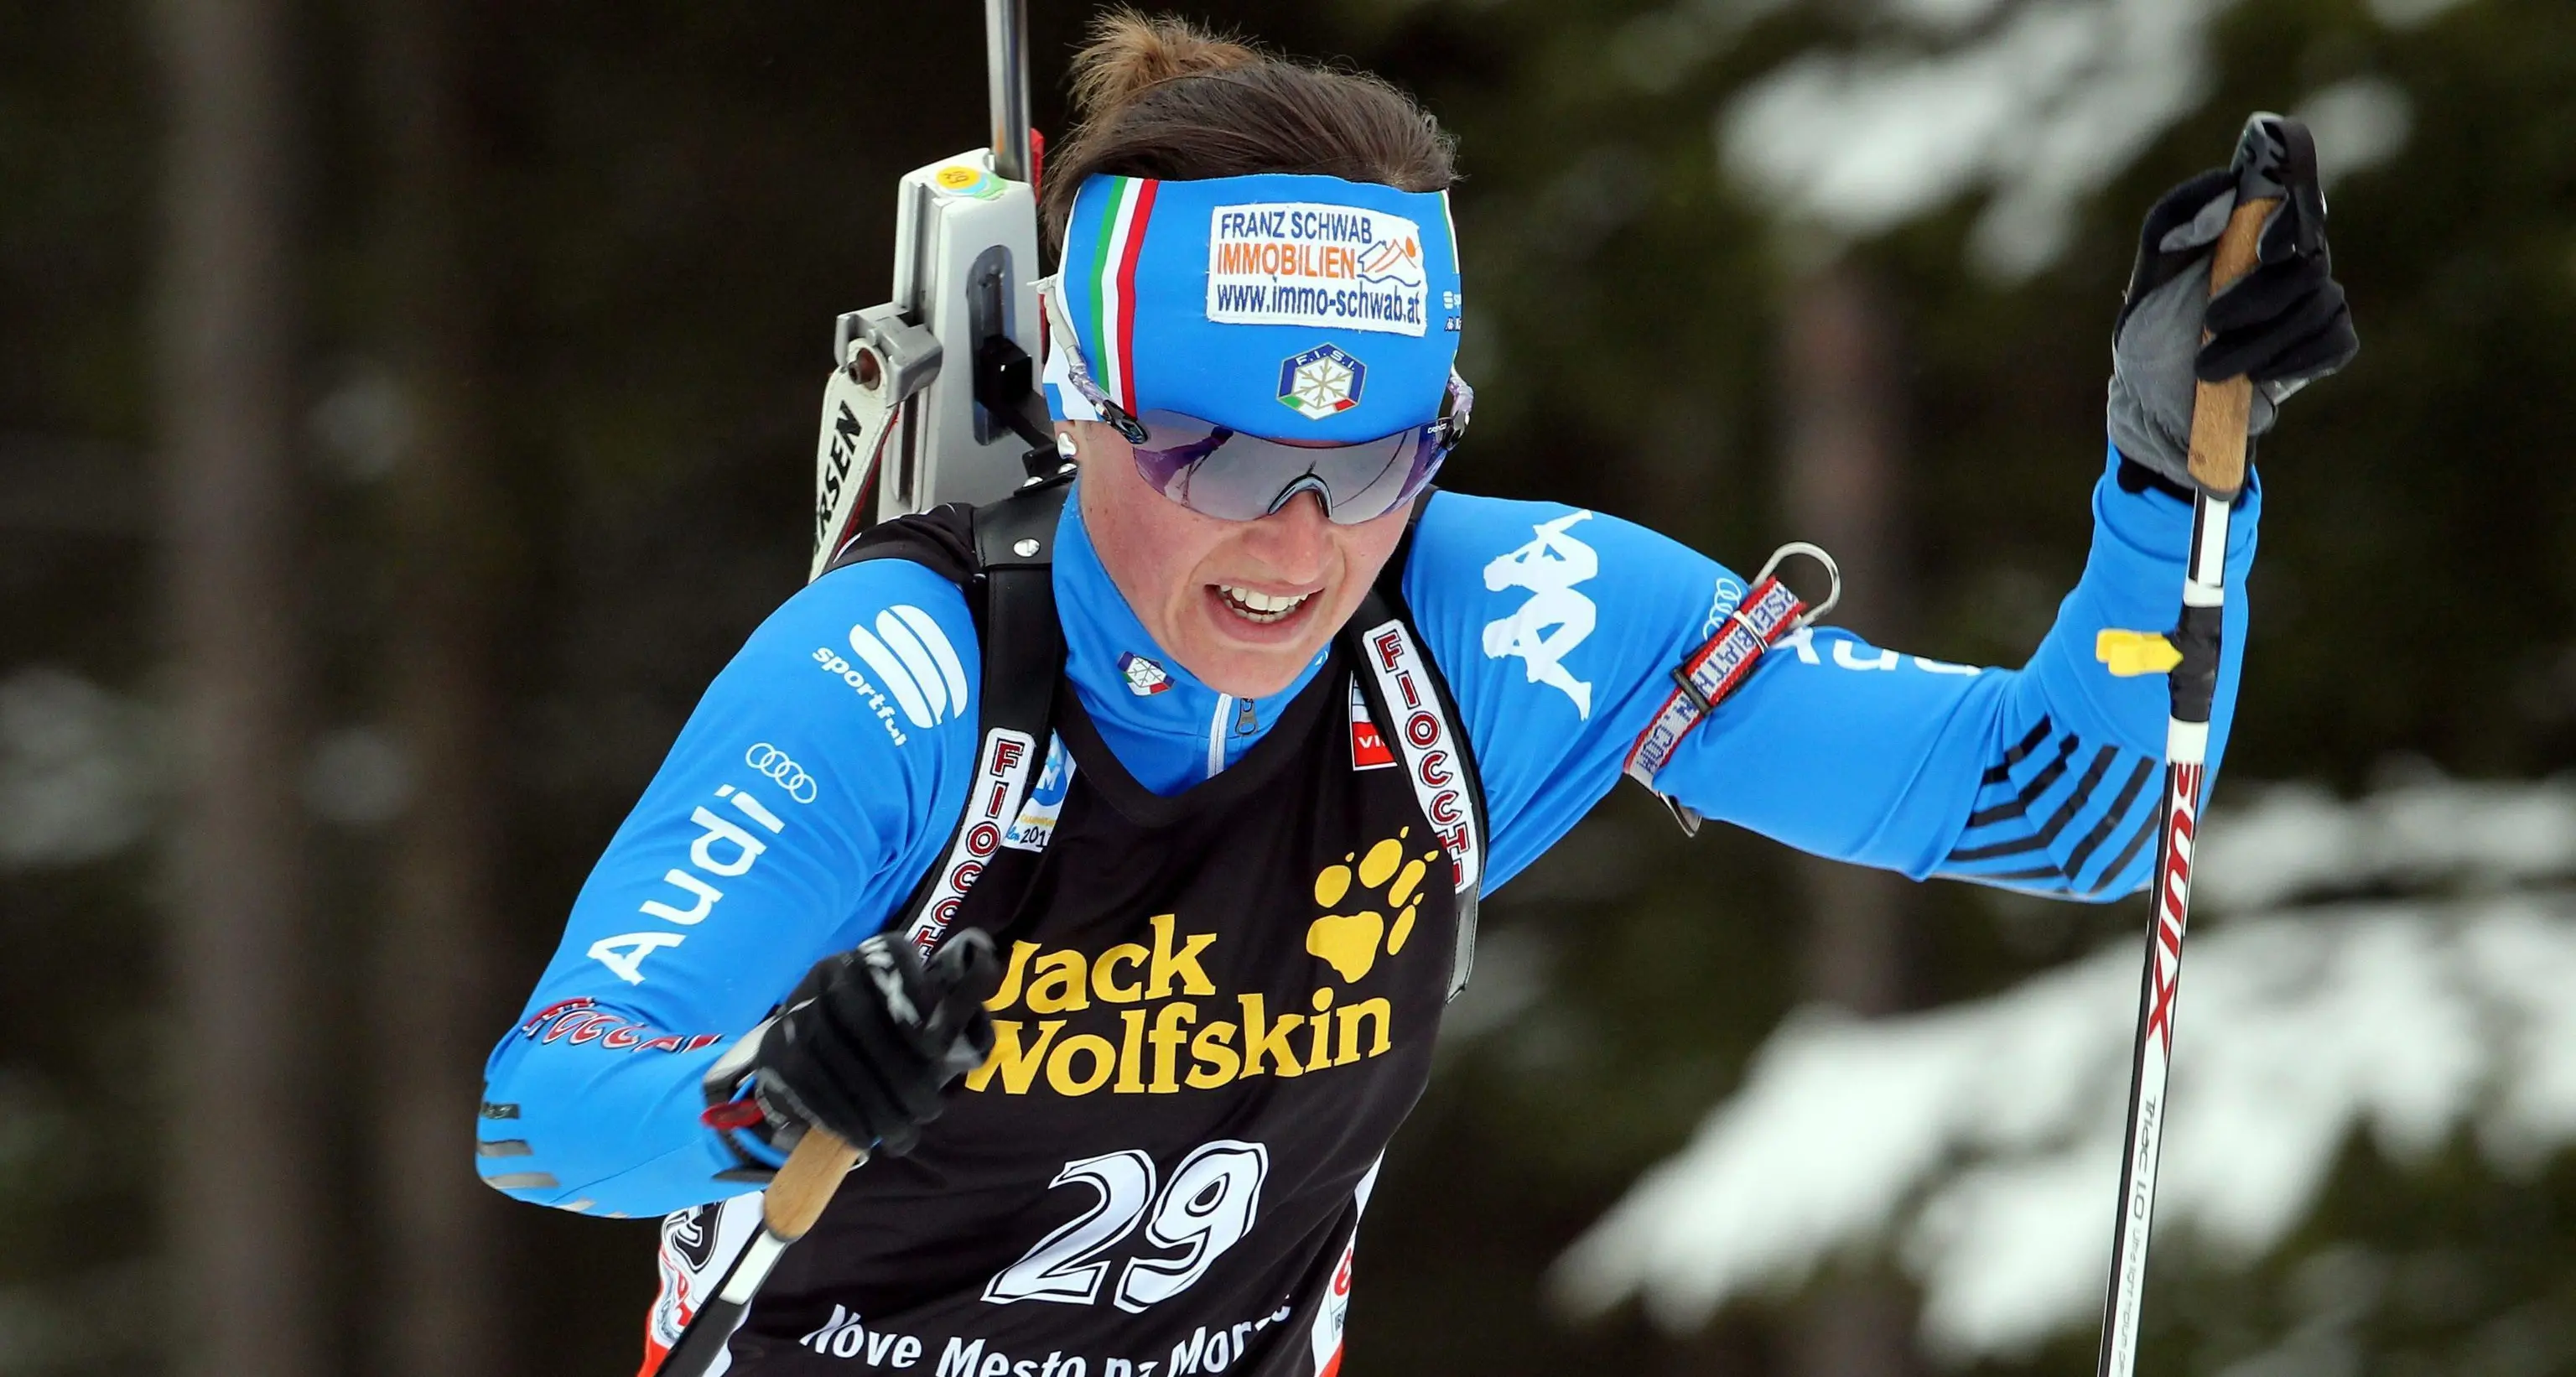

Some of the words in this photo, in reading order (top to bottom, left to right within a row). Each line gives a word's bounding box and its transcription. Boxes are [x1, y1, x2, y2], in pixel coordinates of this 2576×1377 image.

[1217, 242, 1356, 279] IMMOBILIEN
[1220, 211, 1285, 239] FRANZ
[1291, 210, 1373, 244] SCHWAB
[1217, 276, 1421, 326] www.immo-schwab.at
[813, 399, 863, 555] RSEN
[812, 646, 906, 747] sportful
[1373, 629, 1471, 892] FIOCCHI
[586, 783, 786, 986] Audi
[1020, 825, 1052, 849] 201
[984, 913, 1218, 1015] Jack
[963, 987, 1393, 1097] Wolfskin
[980, 1140, 1270, 1314] 29
[799, 1304, 923, 1369] Nove
[935, 1337, 1088, 1377] Mesto
